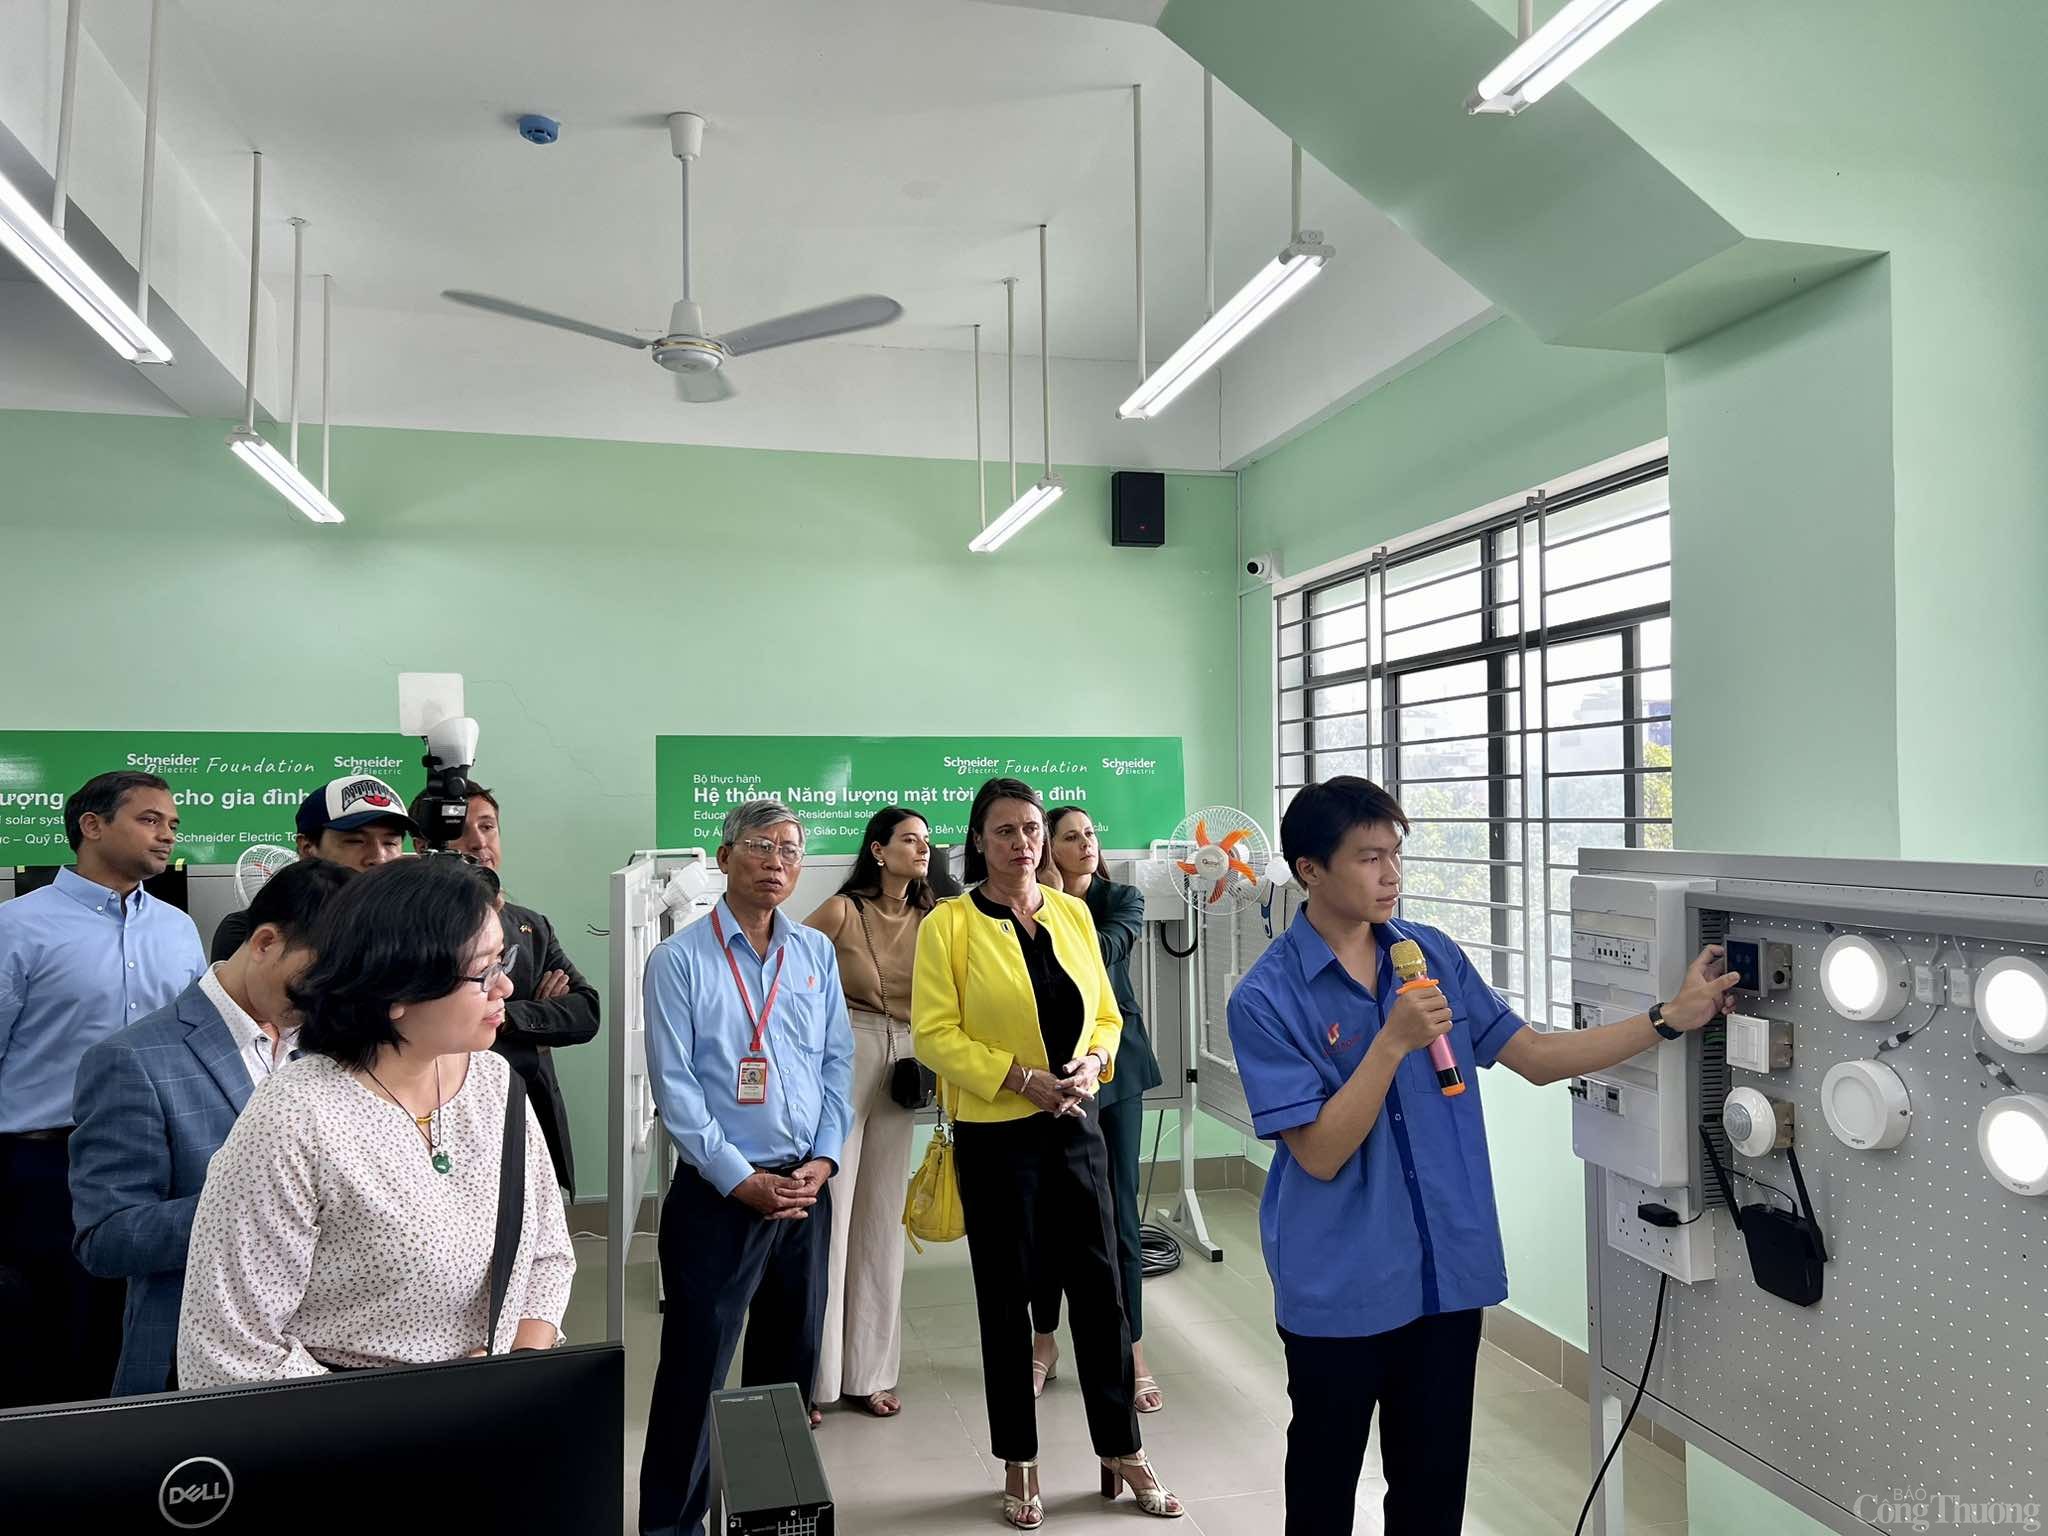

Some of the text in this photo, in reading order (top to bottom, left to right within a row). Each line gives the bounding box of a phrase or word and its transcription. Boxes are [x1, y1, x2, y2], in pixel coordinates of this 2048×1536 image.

[127, 753, 200, 765] Schneider
[205, 757, 315, 773] Foundation
[334, 756, 403, 767] Schneider
[943, 756, 1000, 767] Schneider
[1102, 758, 1156, 768] Schneider
[1004, 759, 1088, 774] Foundation
[693, 774, 762, 785] Bộ thực hành
[0, 792, 65, 810] ượng
[172, 788, 214, 805] cho
[221, 788, 255, 810] gia
[694, 784, 974, 806] Hệ thống Năng lượng mặt trời
[1049, 786, 1087, 801] đình
[5, 815, 37, 825] solar
[39, 815, 65, 827] syst
[694, 810, 728, 820] Educa
[798, 809, 852, 819] Residential
[175, 832, 236, 843] Schneider
[239, 832, 282, 842] Electric
[694, 826, 724, 839] Dự Á
[813, 825, 837, 836] Giáo
[839, 826, 860, 838] Dục
[25, 833, 51, 846] Quỹ
[169, 1482, 226, 1504] DELL
